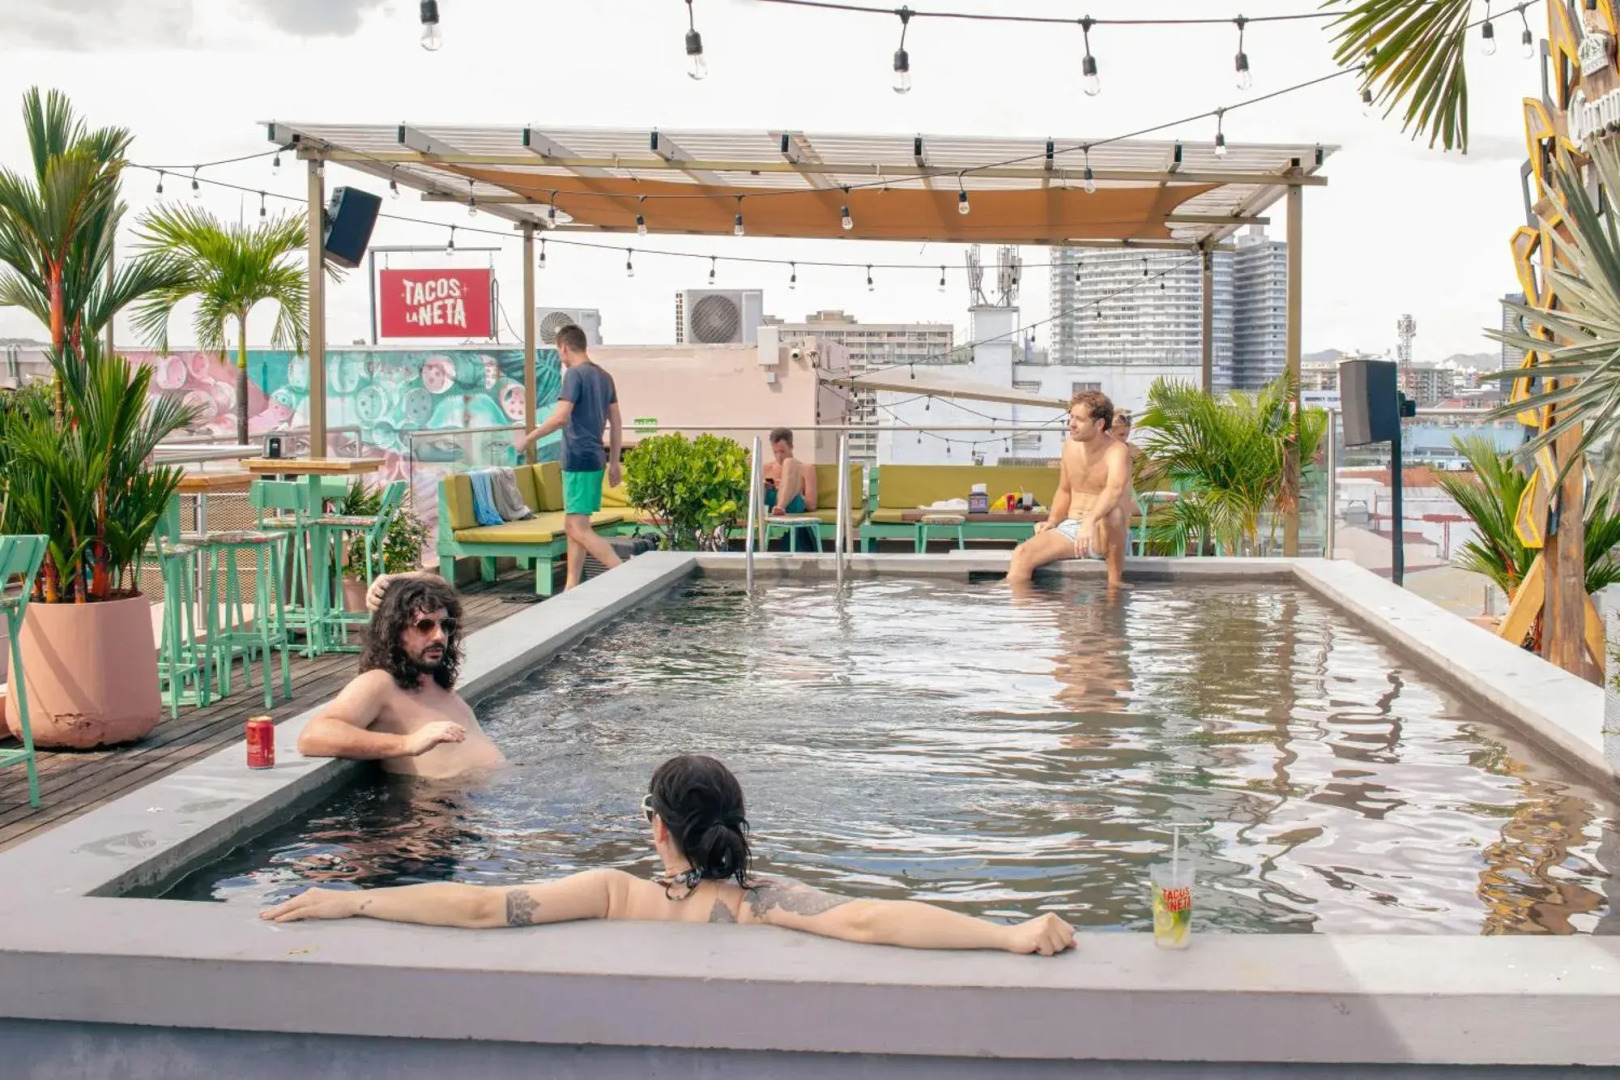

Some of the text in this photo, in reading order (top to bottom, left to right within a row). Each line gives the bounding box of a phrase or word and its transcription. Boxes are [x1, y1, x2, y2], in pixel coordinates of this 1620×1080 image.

[402, 278, 461, 306] TACOS
[406, 298, 467, 329] LA NETA
